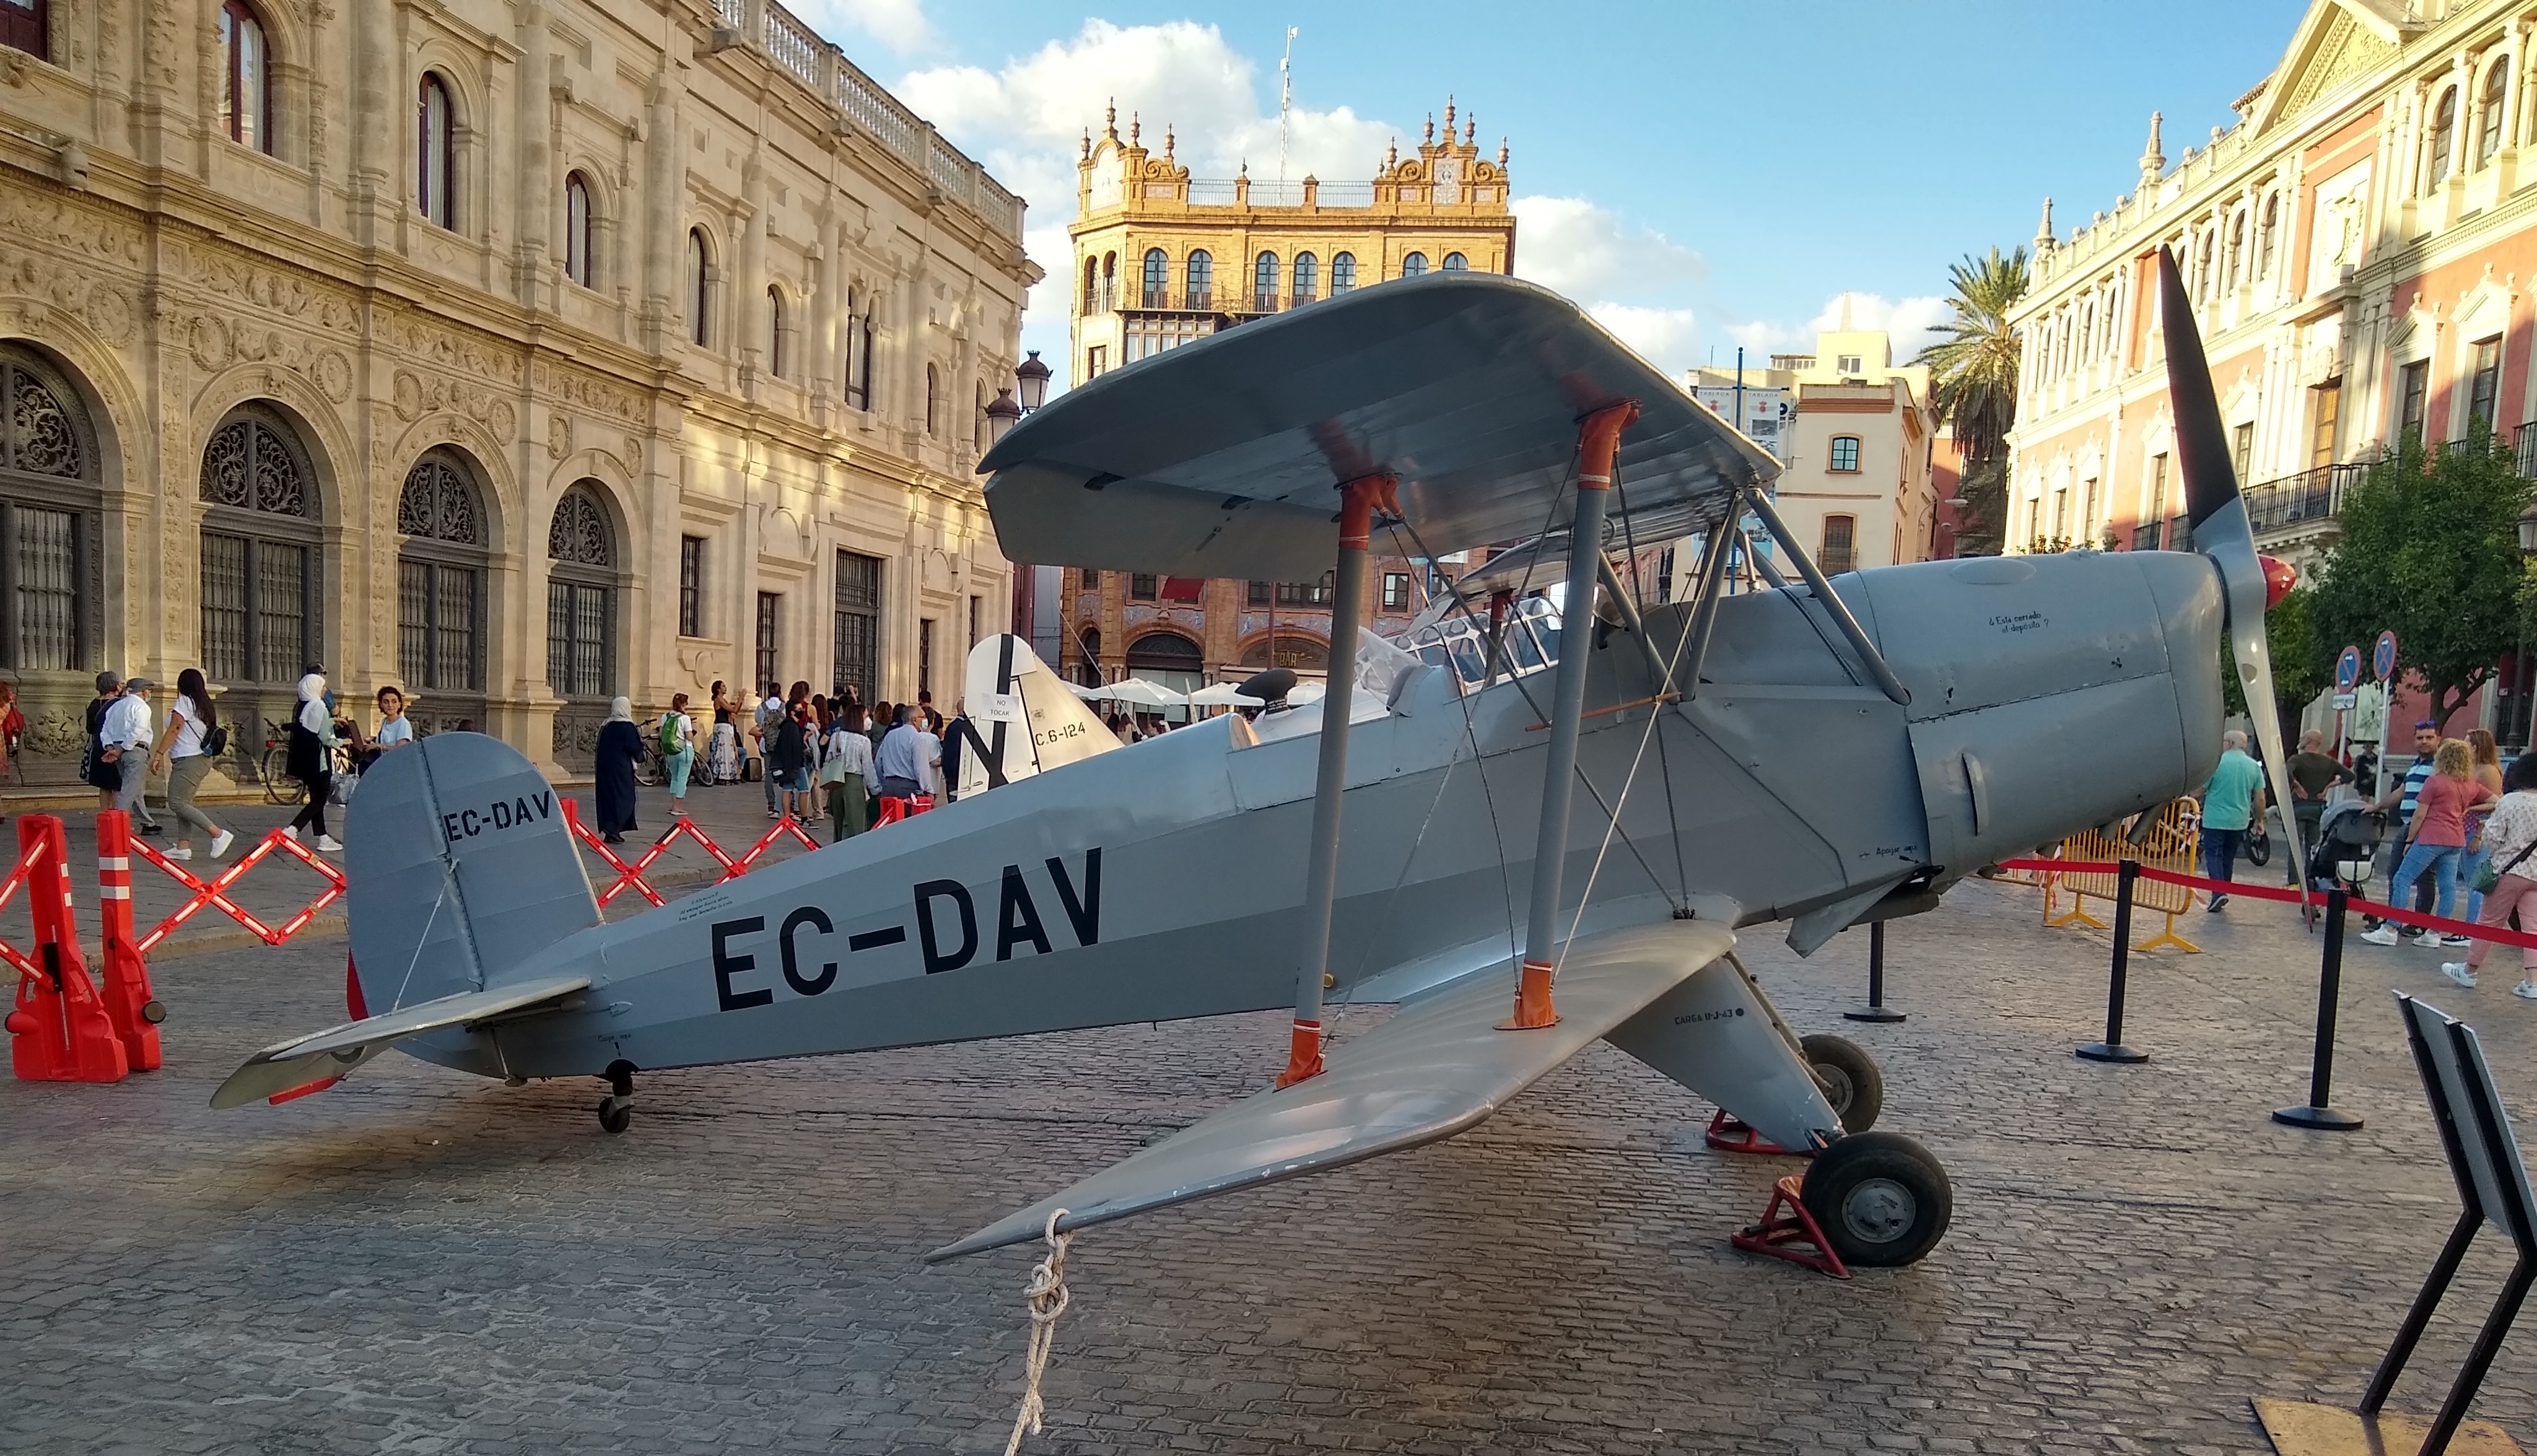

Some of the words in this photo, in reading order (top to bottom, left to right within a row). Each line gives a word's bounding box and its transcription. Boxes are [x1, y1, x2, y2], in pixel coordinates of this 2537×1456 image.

[2014, 610, 2041, 622] cerrado
[1279, 650, 1296, 667] BAR
[1035, 721, 1086, 746] C.6-124
[443, 790, 550, 842] EC-DAV
[711, 847, 1102, 1013] EC-DAV
[1674, 1014, 1703, 1025] CARGA
